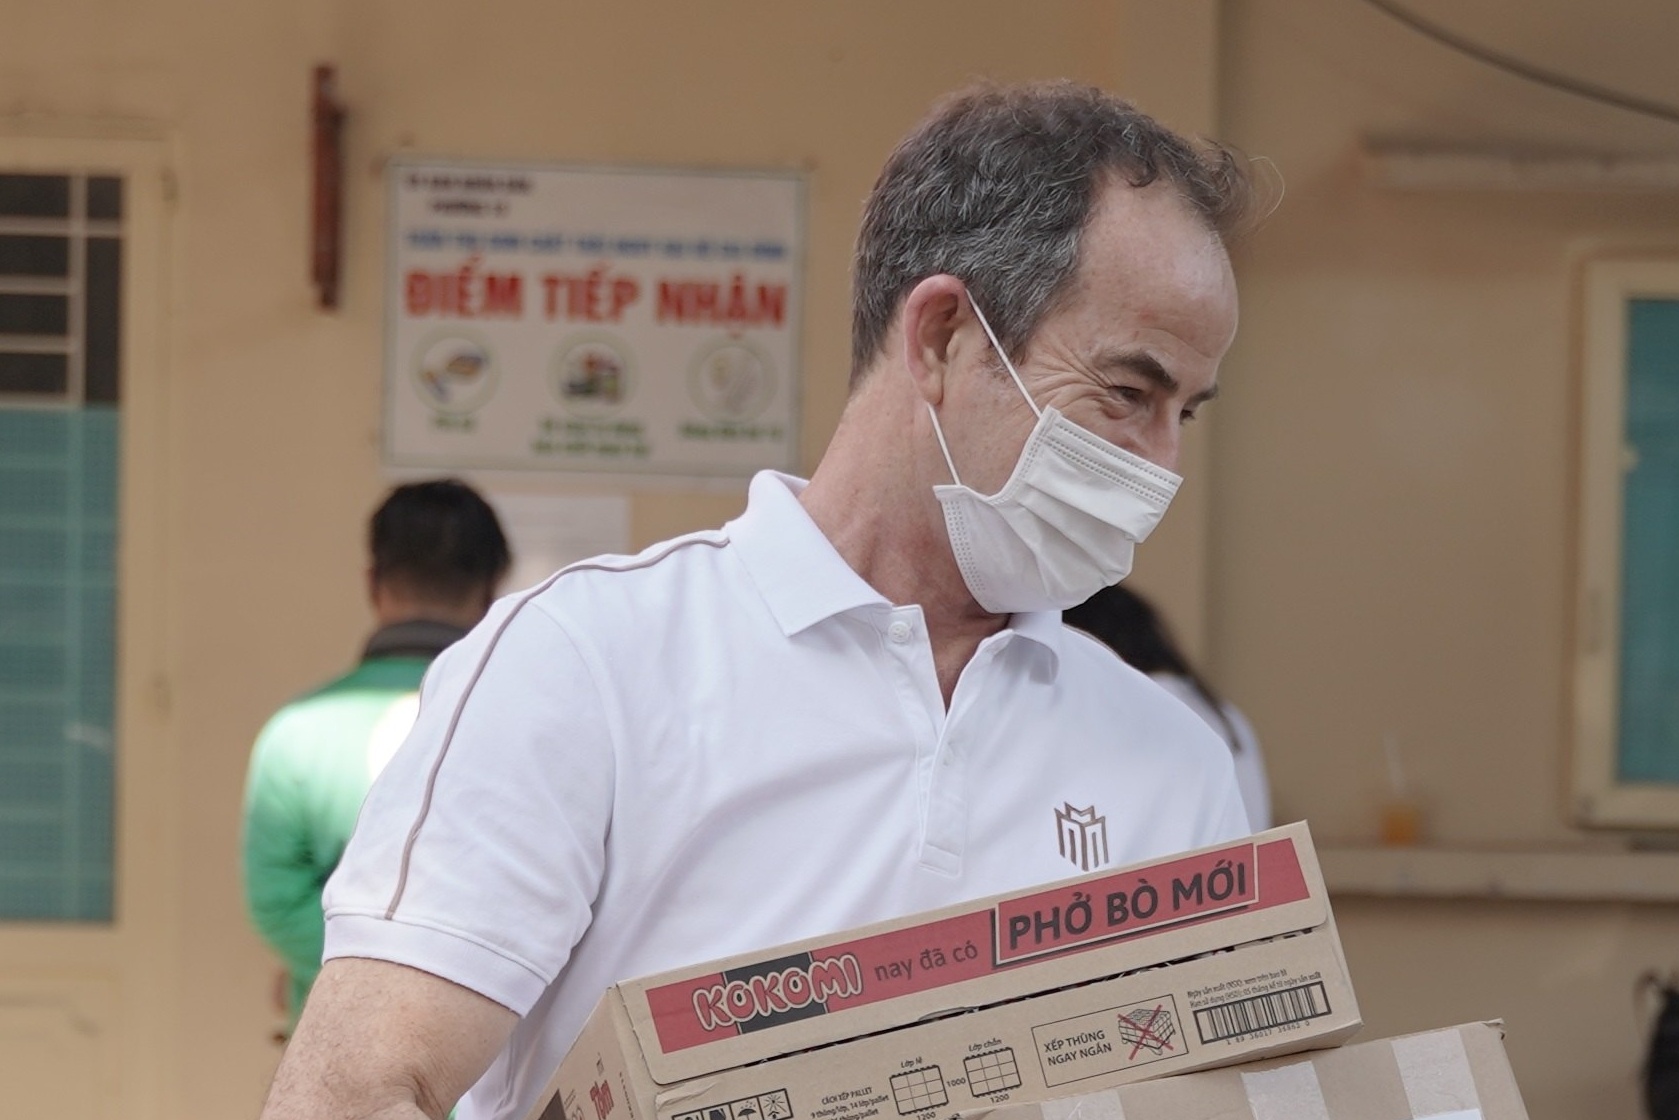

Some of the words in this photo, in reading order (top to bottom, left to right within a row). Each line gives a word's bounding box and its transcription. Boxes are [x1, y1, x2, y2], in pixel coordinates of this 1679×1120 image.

[406, 251, 524, 319] ĐIỂM
[541, 258, 640, 324] TIẾP
[656, 267, 787, 338] NHẬN
[693, 952, 863, 1032] KOKOMI
[875, 956, 913, 982] nay
[919, 944, 946, 970] đã
[952, 940, 978, 963] có
[1008, 891, 1093, 950] PHỞ
[1106, 879, 1157, 927] BÒ
[1172, 859, 1246, 911] MỚI
[1043, 1036, 1065, 1053] XẾP
[1047, 1051, 1078, 1066] NGAY
[947, 1077, 966, 1087] 1000
[990, 1094, 1010, 1103] 1200
